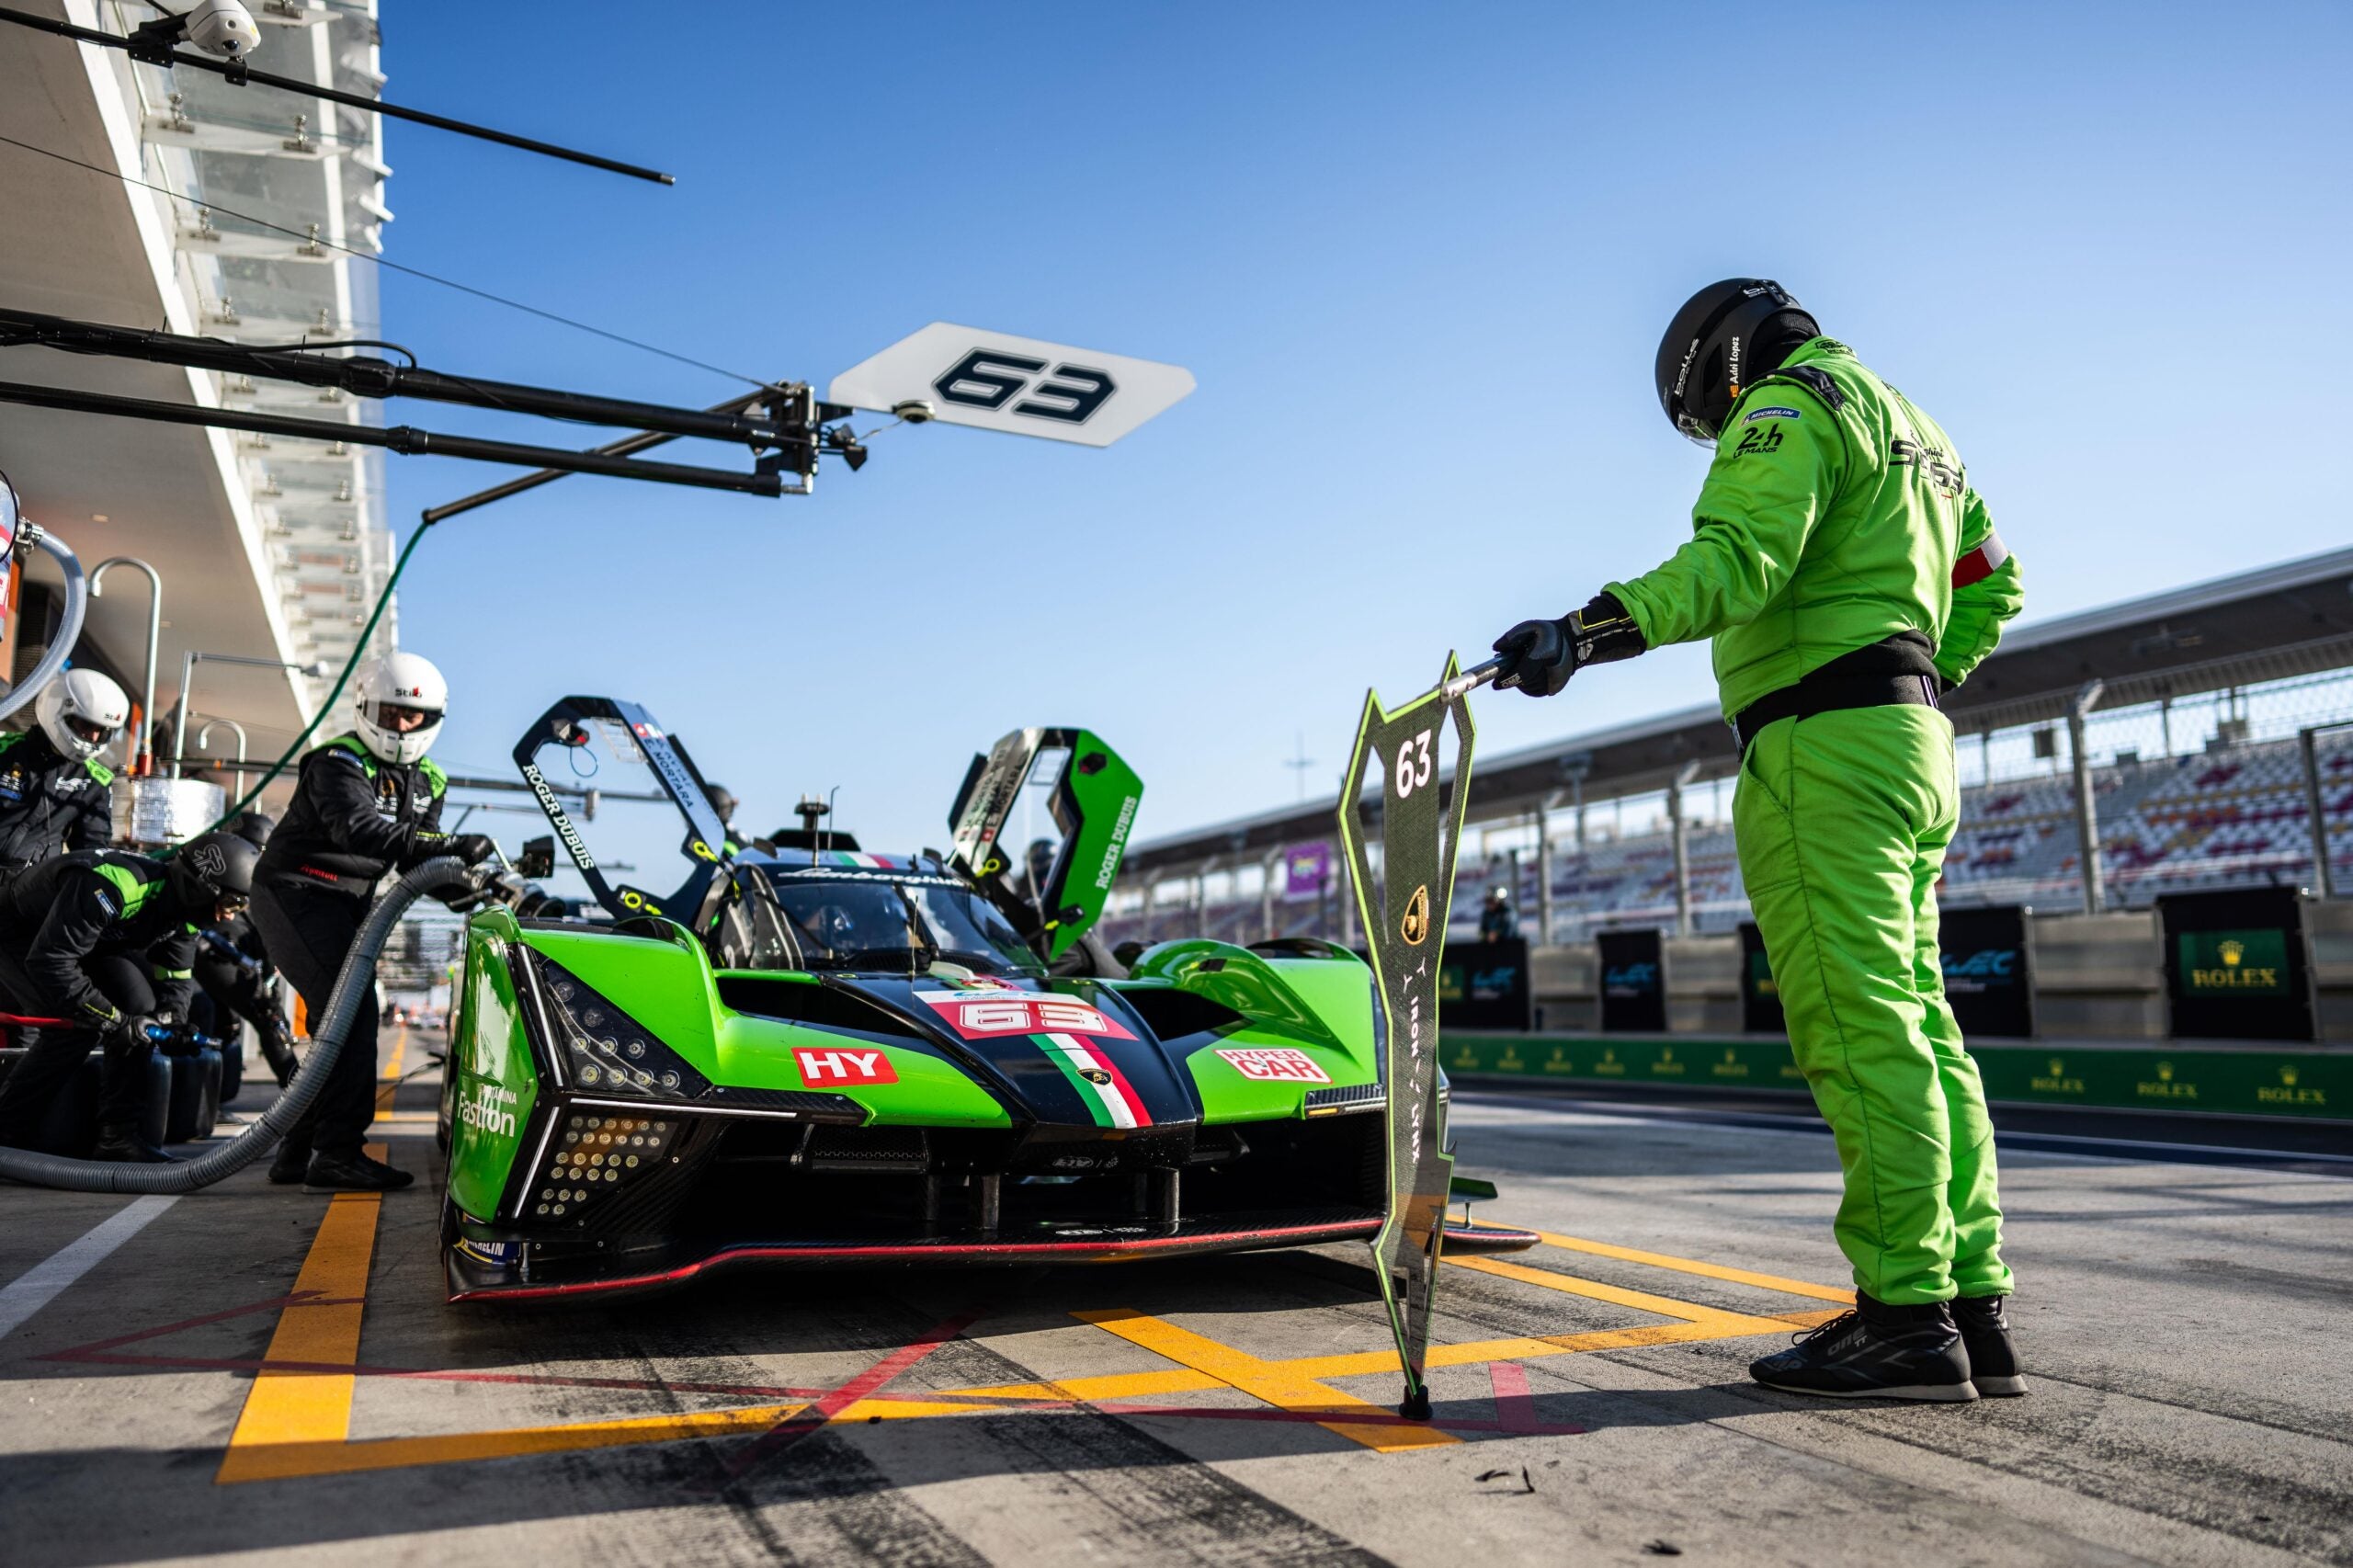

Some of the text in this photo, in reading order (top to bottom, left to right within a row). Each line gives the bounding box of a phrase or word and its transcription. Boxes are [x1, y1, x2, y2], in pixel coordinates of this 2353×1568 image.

[1729, 336, 1740, 384] Adri Lopez
[931, 347, 1118, 426] 63
[1750, 409, 1794, 420] MICHELIN
[1733, 447, 1779, 460] LE MANS
[1501, 675, 1523, 687] OMP
[1396, 729, 1431, 799] 63
[654, 752, 694, 808] MORTARA
[523, 764, 595, 869] ROGER DUBUIS
[1096, 795, 1137, 890] ROGER DUBUIS
[2191, 968, 2278, 988] ROLEX
[959, 1003, 1108, 1032] 63
[799, 1052, 879, 1079] HY
[1222, 1051, 1303, 1060] HYPER
[1237, 1059, 1324, 1079] CAR
[1410, 995, 1420, 1165] IRON LYNX
[2137, 1081, 2199, 1098] ROLEX
[2256, 1085, 2326, 1105] ROLEX
[458, 1090, 515, 1138] Fastron
[1827, 1324, 1867, 1357] one
